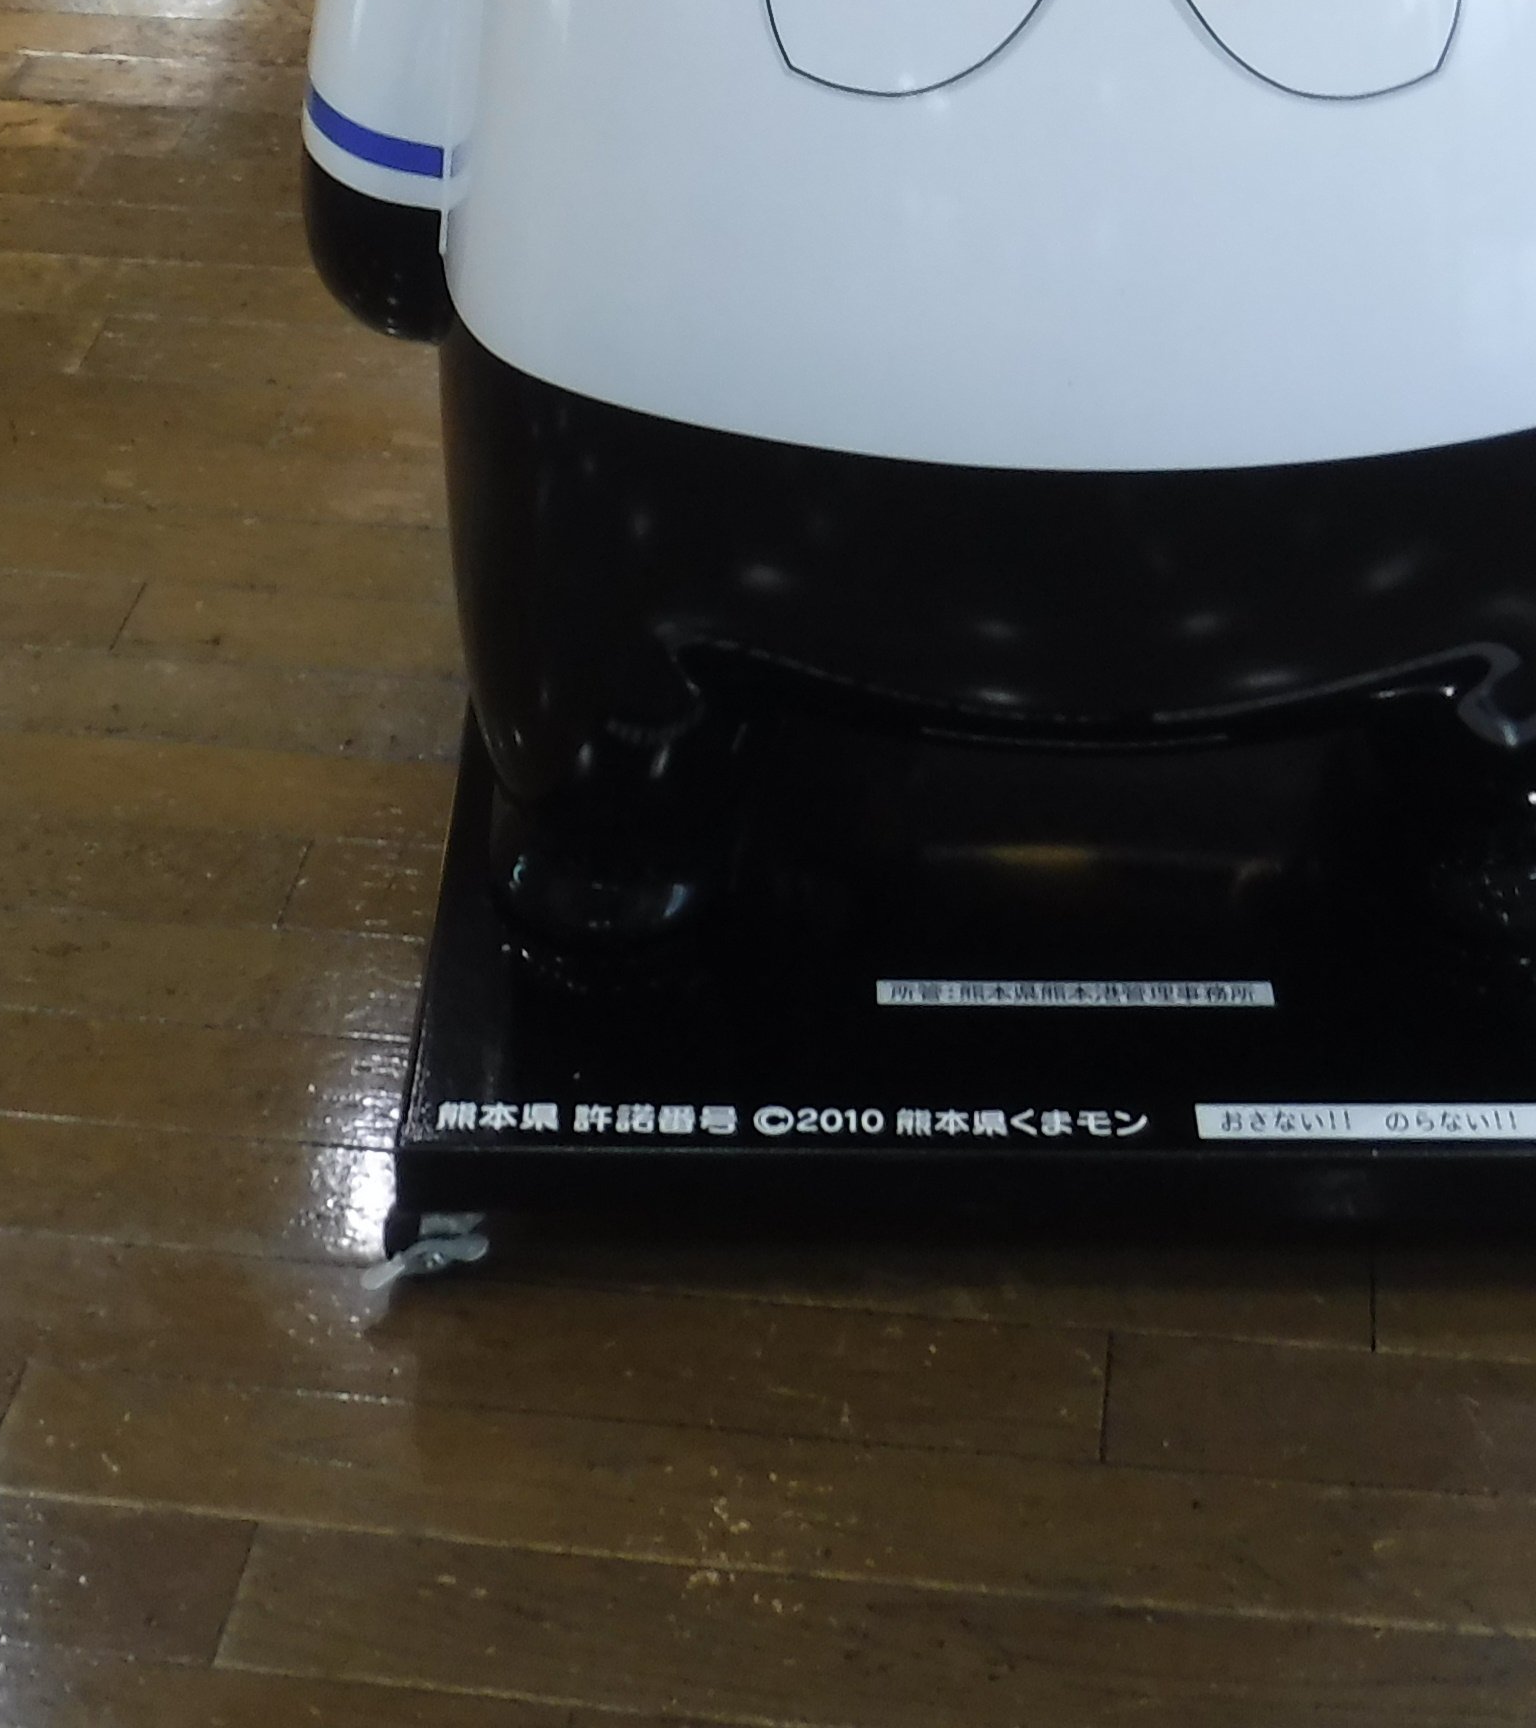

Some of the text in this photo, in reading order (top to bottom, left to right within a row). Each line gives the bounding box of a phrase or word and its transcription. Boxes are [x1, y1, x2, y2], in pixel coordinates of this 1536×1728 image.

[435, 1101, 560, 1133] 熊本県
[895, 1108, 1150, 1138] 熊本県くまモン
